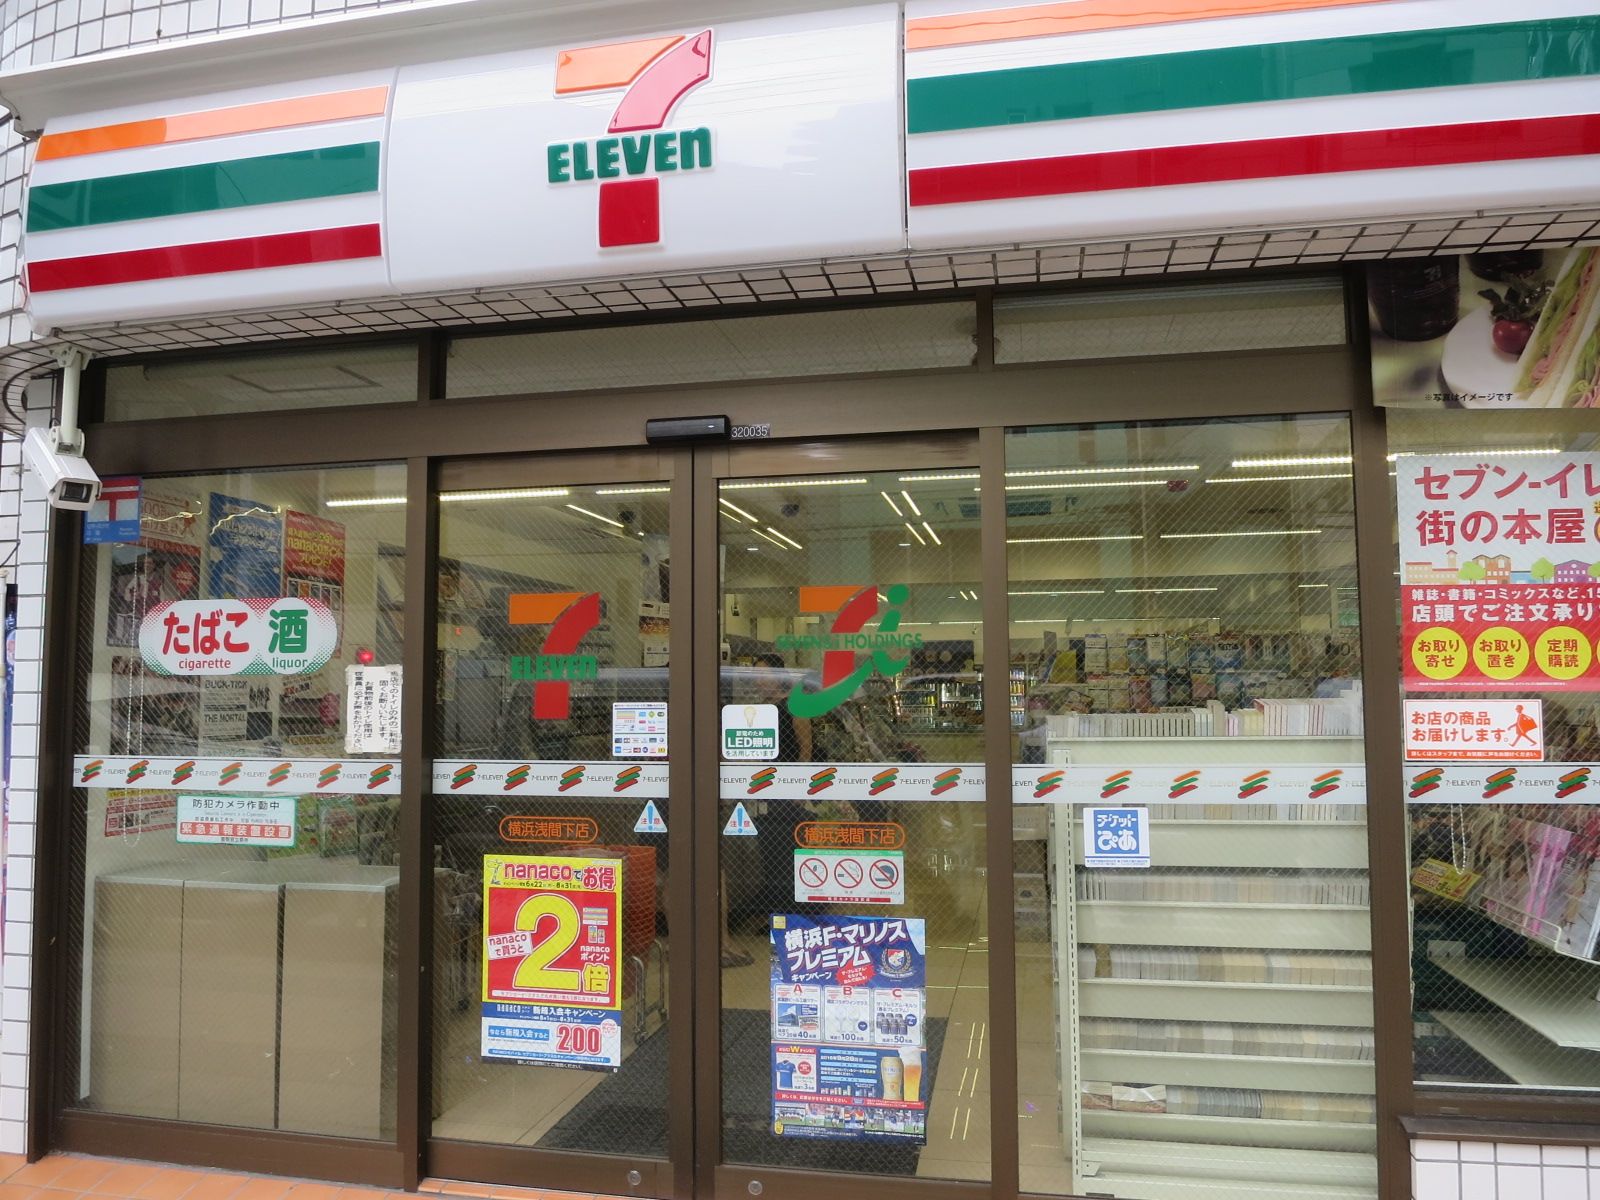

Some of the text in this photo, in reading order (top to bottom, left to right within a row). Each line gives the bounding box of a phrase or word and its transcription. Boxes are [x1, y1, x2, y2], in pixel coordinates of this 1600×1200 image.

[731, 425, 768, 438] 320035
[1415, 507, 1586, 546] 街の本屋
[1411, 602, 1600, 623] 店頭でご注文承り
[162, 608, 250, 655] たばこ
[268, 608, 309, 654] 酒
[844, 632, 924, 649] HOLDINGS
[1418, 639, 1460, 653] お取り
[1479, 639, 1522, 653] お取り
[1547, 638, 1578, 653] 定期
[178, 658, 231, 671] cigarette
[272, 657, 308, 670] liquor
[1425, 654, 1456, 668] 寄せ
[1487, 654, 1516, 668] 置き
[1547, 654, 1579, 668] 購読
[204, 713, 218, 722] THE
[1411, 711, 1491, 725] お店の商品
[727, 737, 773, 748] LED照明
[1411, 728, 1509, 743] お届けします。
[192, 798, 280, 810] 防犯カメラ作動中
[1096, 813, 1137, 828] チケット
[508, 821, 590, 838] 横浜浅間下店
[803, 827, 897, 845] 横浜浅間下店
[1096, 829, 1137, 851] ぴあ
[504, 863, 617, 891] nanacoでお得
[489, 933, 527, 946] nanaco
[512, 892, 581, 993] 2
[495, 943, 525, 956] で買うと
[580, 945, 610, 953] nanaco
[580, 952, 610, 961] ポイント
[787, 945, 871, 972] プレミアム
[582, 962, 610, 993] 倍
[791, 971, 832, 983] キャンペーン
[793, 984, 803, 993] A
[842, 987, 852, 996] B
[892, 988, 902, 998] C
[556, 1024, 602, 1055] 200
